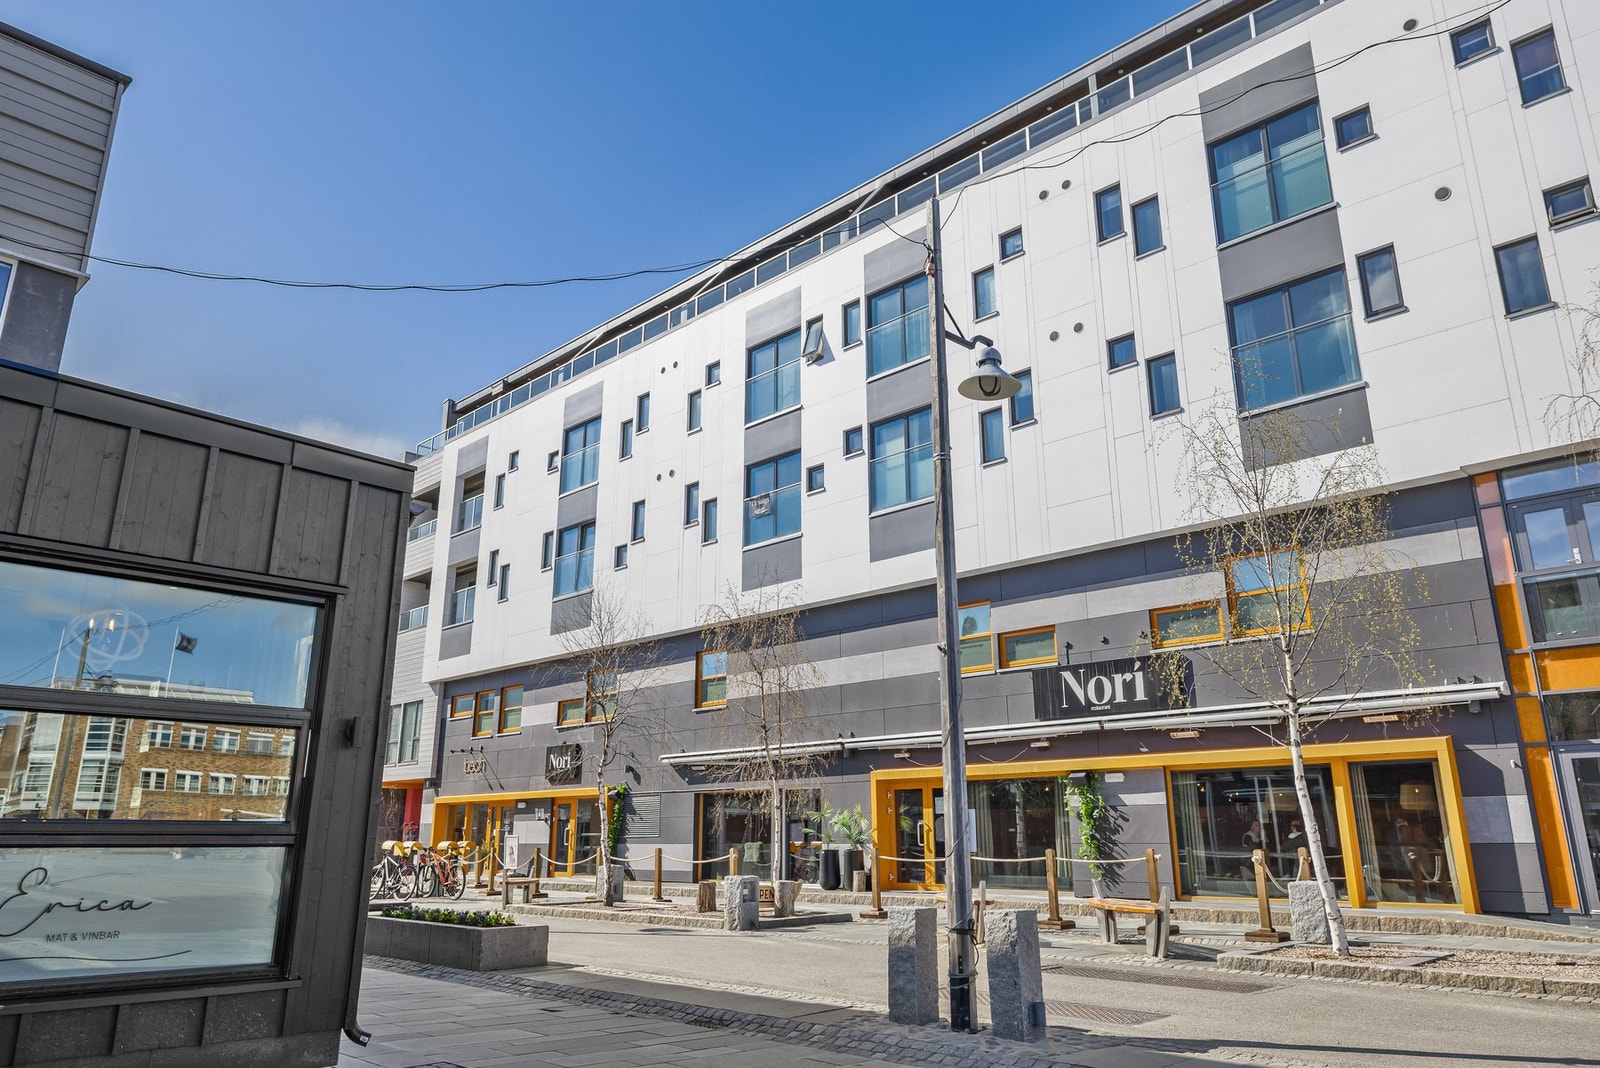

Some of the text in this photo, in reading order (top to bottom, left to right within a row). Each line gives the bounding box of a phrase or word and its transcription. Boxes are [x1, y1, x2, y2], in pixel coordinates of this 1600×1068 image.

[759, 889, 774, 899] PEN
[0, 867, 152, 937] Erica
[46, 931, 121, 942] MAT & VINBAR
